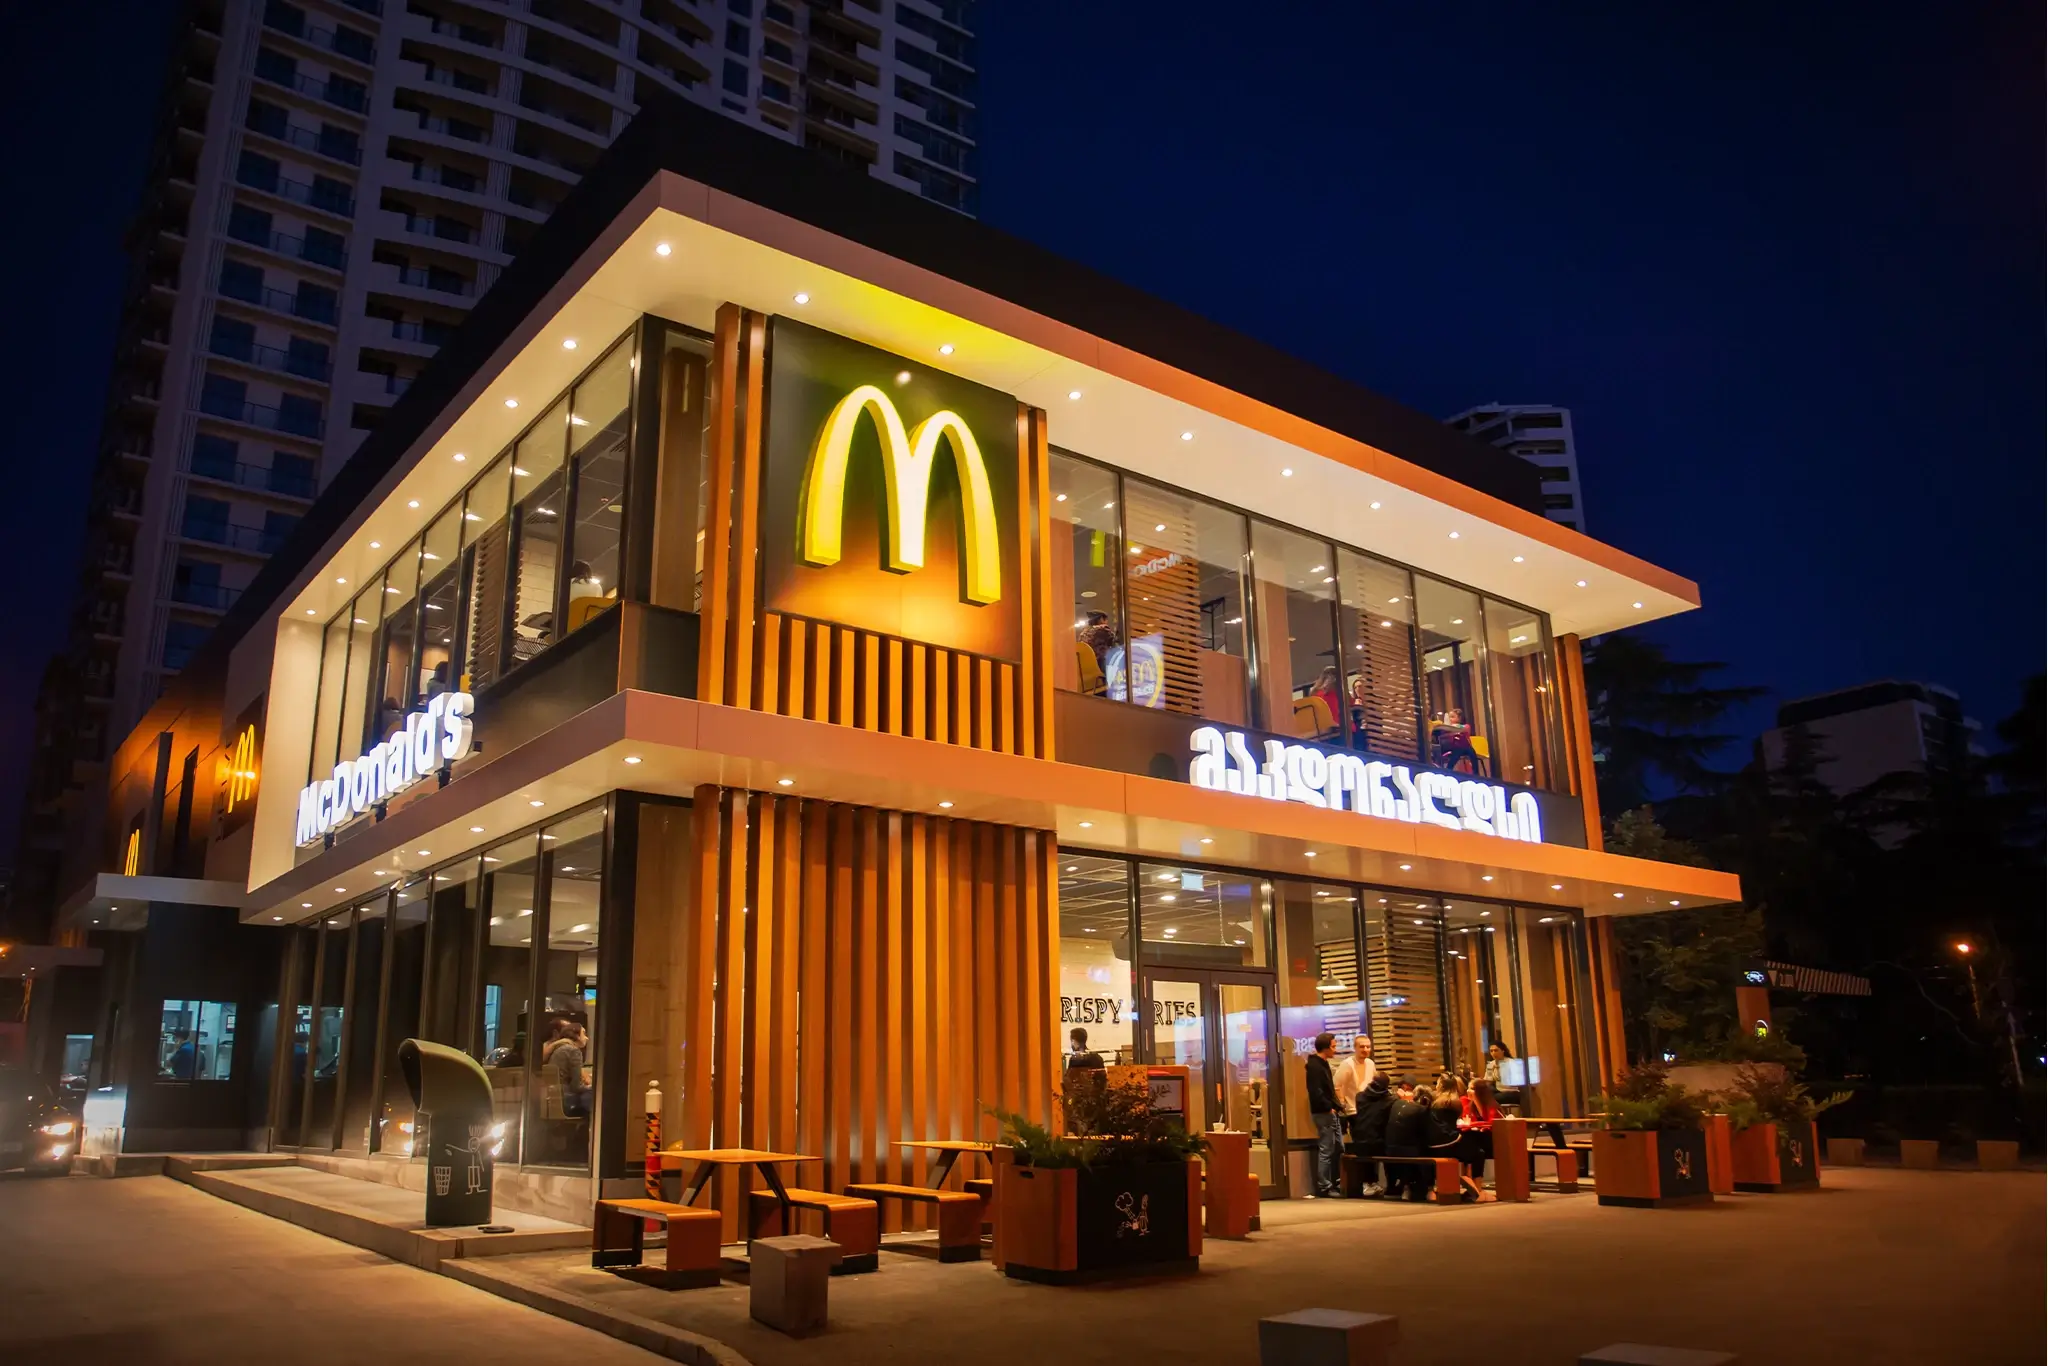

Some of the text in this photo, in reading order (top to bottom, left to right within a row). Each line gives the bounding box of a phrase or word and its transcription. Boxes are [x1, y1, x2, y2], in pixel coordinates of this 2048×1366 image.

[296, 691, 475, 848] McDonald's
[1190, 726, 1542, 843] მაკდონალდსი
[1060, 996, 1197, 1026] RISPY RIES
